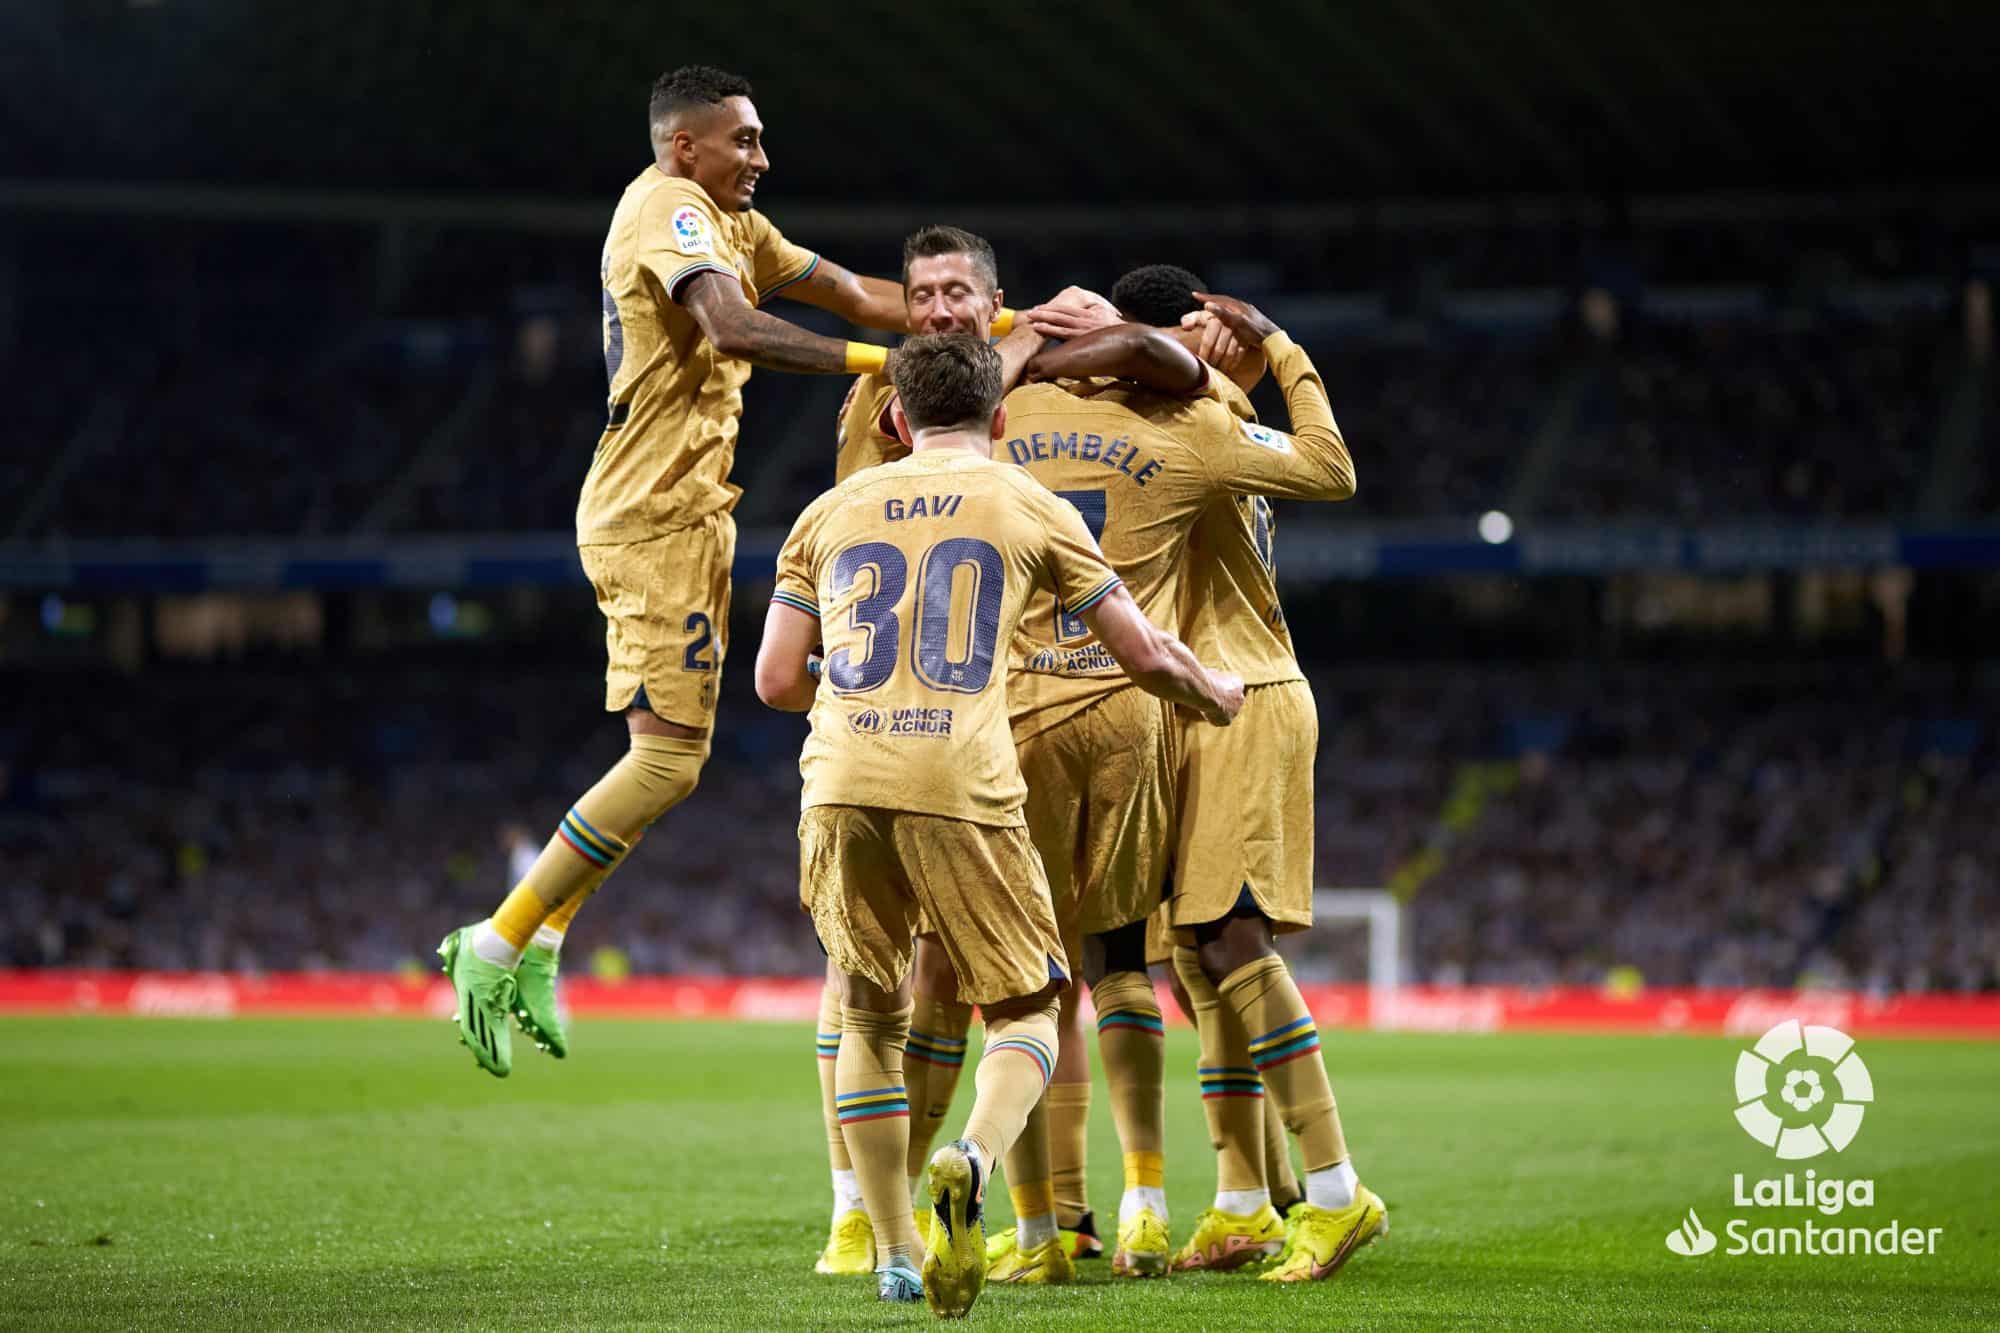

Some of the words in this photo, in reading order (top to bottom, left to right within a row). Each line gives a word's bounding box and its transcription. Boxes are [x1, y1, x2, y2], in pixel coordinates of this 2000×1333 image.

[1006, 431, 1166, 487] DEMBÉLÉ
[885, 495, 963, 522] GAVI
[829, 537, 1005, 694] 30
[889, 720, 951, 734] ACNUR
[892, 708, 952, 721] UNHCR
